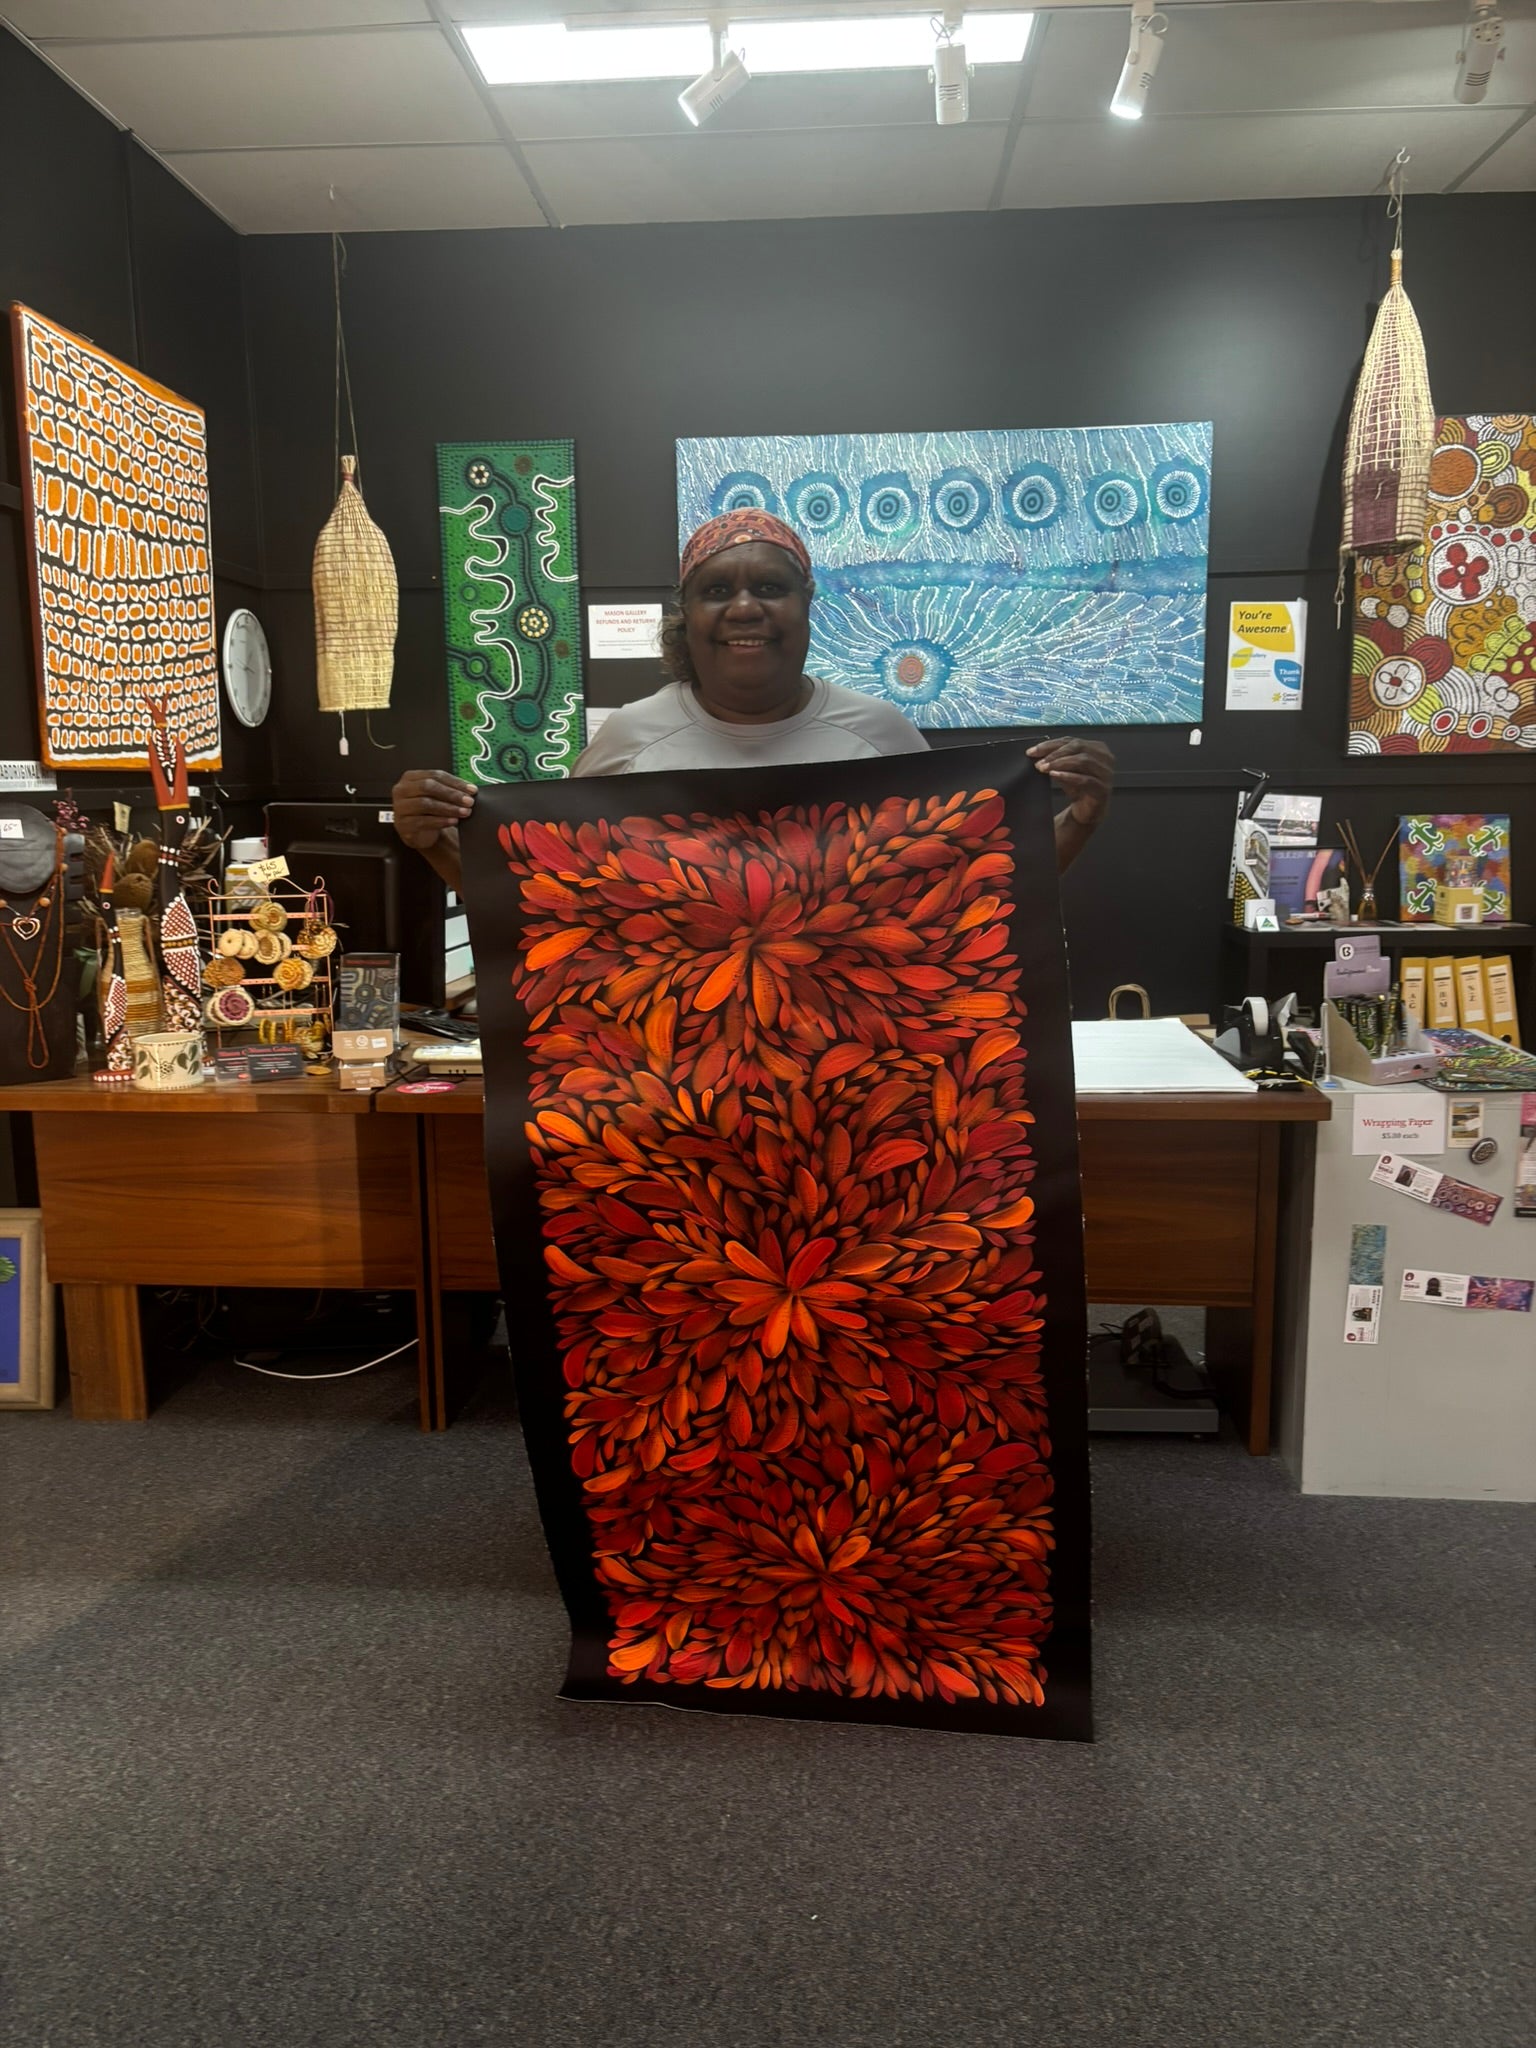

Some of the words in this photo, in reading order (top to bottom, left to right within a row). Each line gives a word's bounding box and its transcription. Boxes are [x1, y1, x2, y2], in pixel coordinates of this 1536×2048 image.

[1239, 610, 1272, 620] You're
[1237, 624, 1292, 633] Awesome!
[1362, 1119, 1407, 1128] Wrapping
[1408, 1118, 1434, 1127] Paper
